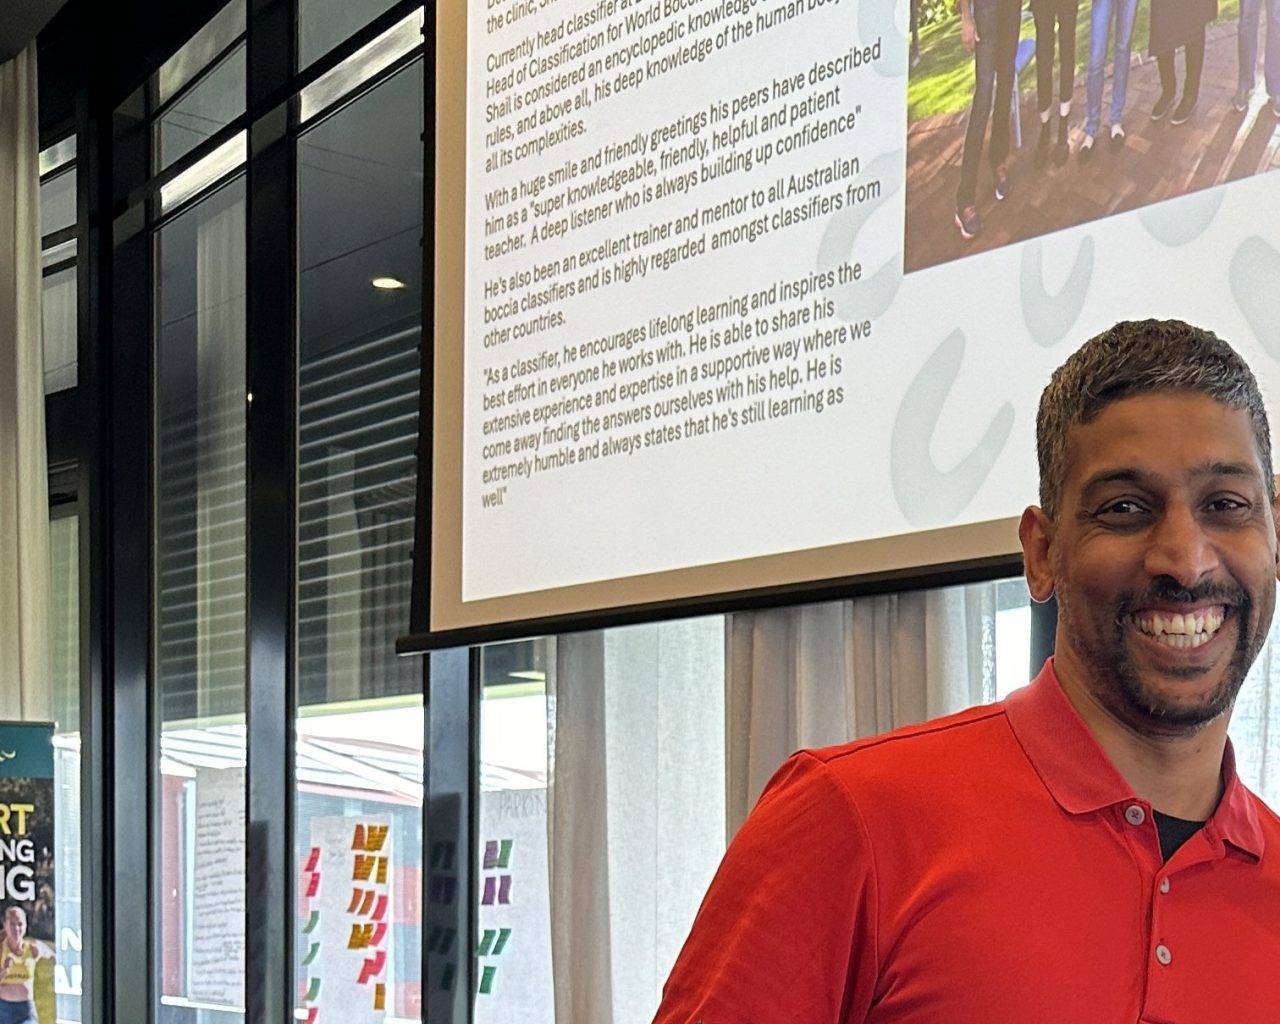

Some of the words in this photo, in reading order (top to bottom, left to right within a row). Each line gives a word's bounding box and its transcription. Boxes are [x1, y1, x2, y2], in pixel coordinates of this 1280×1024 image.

[485, 95, 512, 123] Shail
[524, 61, 585, 106] considered
[587, 58, 602, 78] an
[604, 19, 685, 71] encyclopedic
[486, 13, 503, 34] the
[505, 0, 537, 25] clinic,
[486, 36, 535, 73] Currently
[536, 19, 564, 50] head
[566, 0, 618, 36] classifier
[486, 68, 514, 98] Head
[516, 62, 527, 85] of
[528, 31, 604, 78] Classification
[606, 22, 623, 44] for
[624, 0, 661, 35] World
[484, 187, 508, 211] With
[519, 175, 546, 198] huge
[547, 160, 578, 187] smile
[580, 148, 601, 175] and
[603, 132, 648, 165] friendly
[650, 111, 707, 152] greetings
[709, 99, 729, 124] his
[731, 86, 769, 120] peers
[772, 72, 805, 100] have
[808, 36, 881, 86] described
[485, 124, 514, 148] rules,
[516, 109, 537, 135] and
[539, 98, 572, 125] above
[574, 87, 591, 110] all,
[594, 79, 611, 102] his
[613, 67, 643, 94] deep
[646, 37, 712, 80] knowledge
[715, 24, 729, 50] of
[731, 20, 753, 43] the
[755, 0, 804, 33] human
[484, 215, 504, 236] him
[529, 193, 565, 218] "super
[567, 157, 657, 206] knowledgeable,
[659, 137, 709, 171] friendly,
[712, 114, 758, 152] helpful
[760, 103, 787, 133] and
[789, 84, 840, 127] patient
[484, 233, 526, 261] teacher.
[540, 217, 568, 241] deep
[570, 200, 613, 230] listener
[614, 190, 640, 214] who
[655, 170, 698, 200] always
[700, 147, 753, 183] building
[755, 142, 772, 165] up
[775, 104, 861, 156] confidence"
[485, 151, 498, 173] all
[499, 148, 512, 167] its
[514, 119, 587, 161] complexities.
[484, 276, 507, 300] He's
[508, 270, 531, 291] also
[533, 260, 560, 283] been
[562, 254, 576, 273] an
[578, 233, 631, 267] excellent
[632, 221, 672, 249] trainer
[674, 207, 698, 235] and
[701, 194, 749, 226] mentor
[751, 189, 765, 209] to
[767, 177, 785, 204] all
[786, 156, 859, 198] Australian
[484, 297, 518, 324] boccia
[520, 280, 575, 312] classifiers
[577, 268, 599, 294] and
[613, 254, 649, 283] highly
[650, 232, 705, 271] regarded
[711, 213, 769, 250] amongst
[771, 192, 843, 230] classifiers
[845, 179, 880, 207] from
[482, 408, 530, 435] extensive
[532, 393, 592, 424] experience
[594, 382, 616, 407] and
[619, 372, 673, 402] expertise
[700, 346, 770, 381] supportive
[772, 338, 801, 361] way
[802, 325, 847, 353] where
[849, 320, 871, 341] we
[483, 367, 500, 386] "As
[510, 350, 560, 379] classifier,
[563, 345, 577, 364] he
[579, 325, 646, 359] encourages
[649, 309, 694, 339] lifelong
[696, 293, 748, 326] learning
[750, 282, 776, 310] and
[779, 270, 834, 302] inspires
[837, 261, 861, 285] the
[483, 327, 511, 348] other
[512, 310, 565, 339] countries.
[483, 389, 505, 411] best
[507, 381, 535, 404] effort
[549, 365, 599, 393] everyone
[601, 359, 616, 379] he
[618, 348, 653, 374] works
[655, 338, 686, 364] with.
[689, 332, 707, 355] He
[709, 331, 721, 349] is
[723, 320, 752, 346] able
[754, 317, 769, 337] to
[771, 306, 810, 332] share
[813, 299, 834, 321] his
[482, 439, 511, 460] come
[513, 432, 541, 452] away
[542, 420, 580, 445] finding
[581, 415, 600, 436] the
[602, 404, 651, 431] answers
[653, 389, 713, 418] ourselves
[715, 377, 743, 403] with
[746, 374, 766, 396] his
[769, 364, 803, 391] help.
[806, 357, 826, 382] He
[482, 456, 533, 484] extremely
[534, 446, 575, 472] humble
[577, 438, 599, 462] and
[601, 433, 641, 457] always
[644, 424, 681, 447] states
[684, 414, 709, 438] that
[712, 407, 738, 432] he's
[741, 399, 765, 425] still
[768, 388, 824, 419] learning
[826, 386, 844, 406] as
[482, 485, 507, 508] well"
